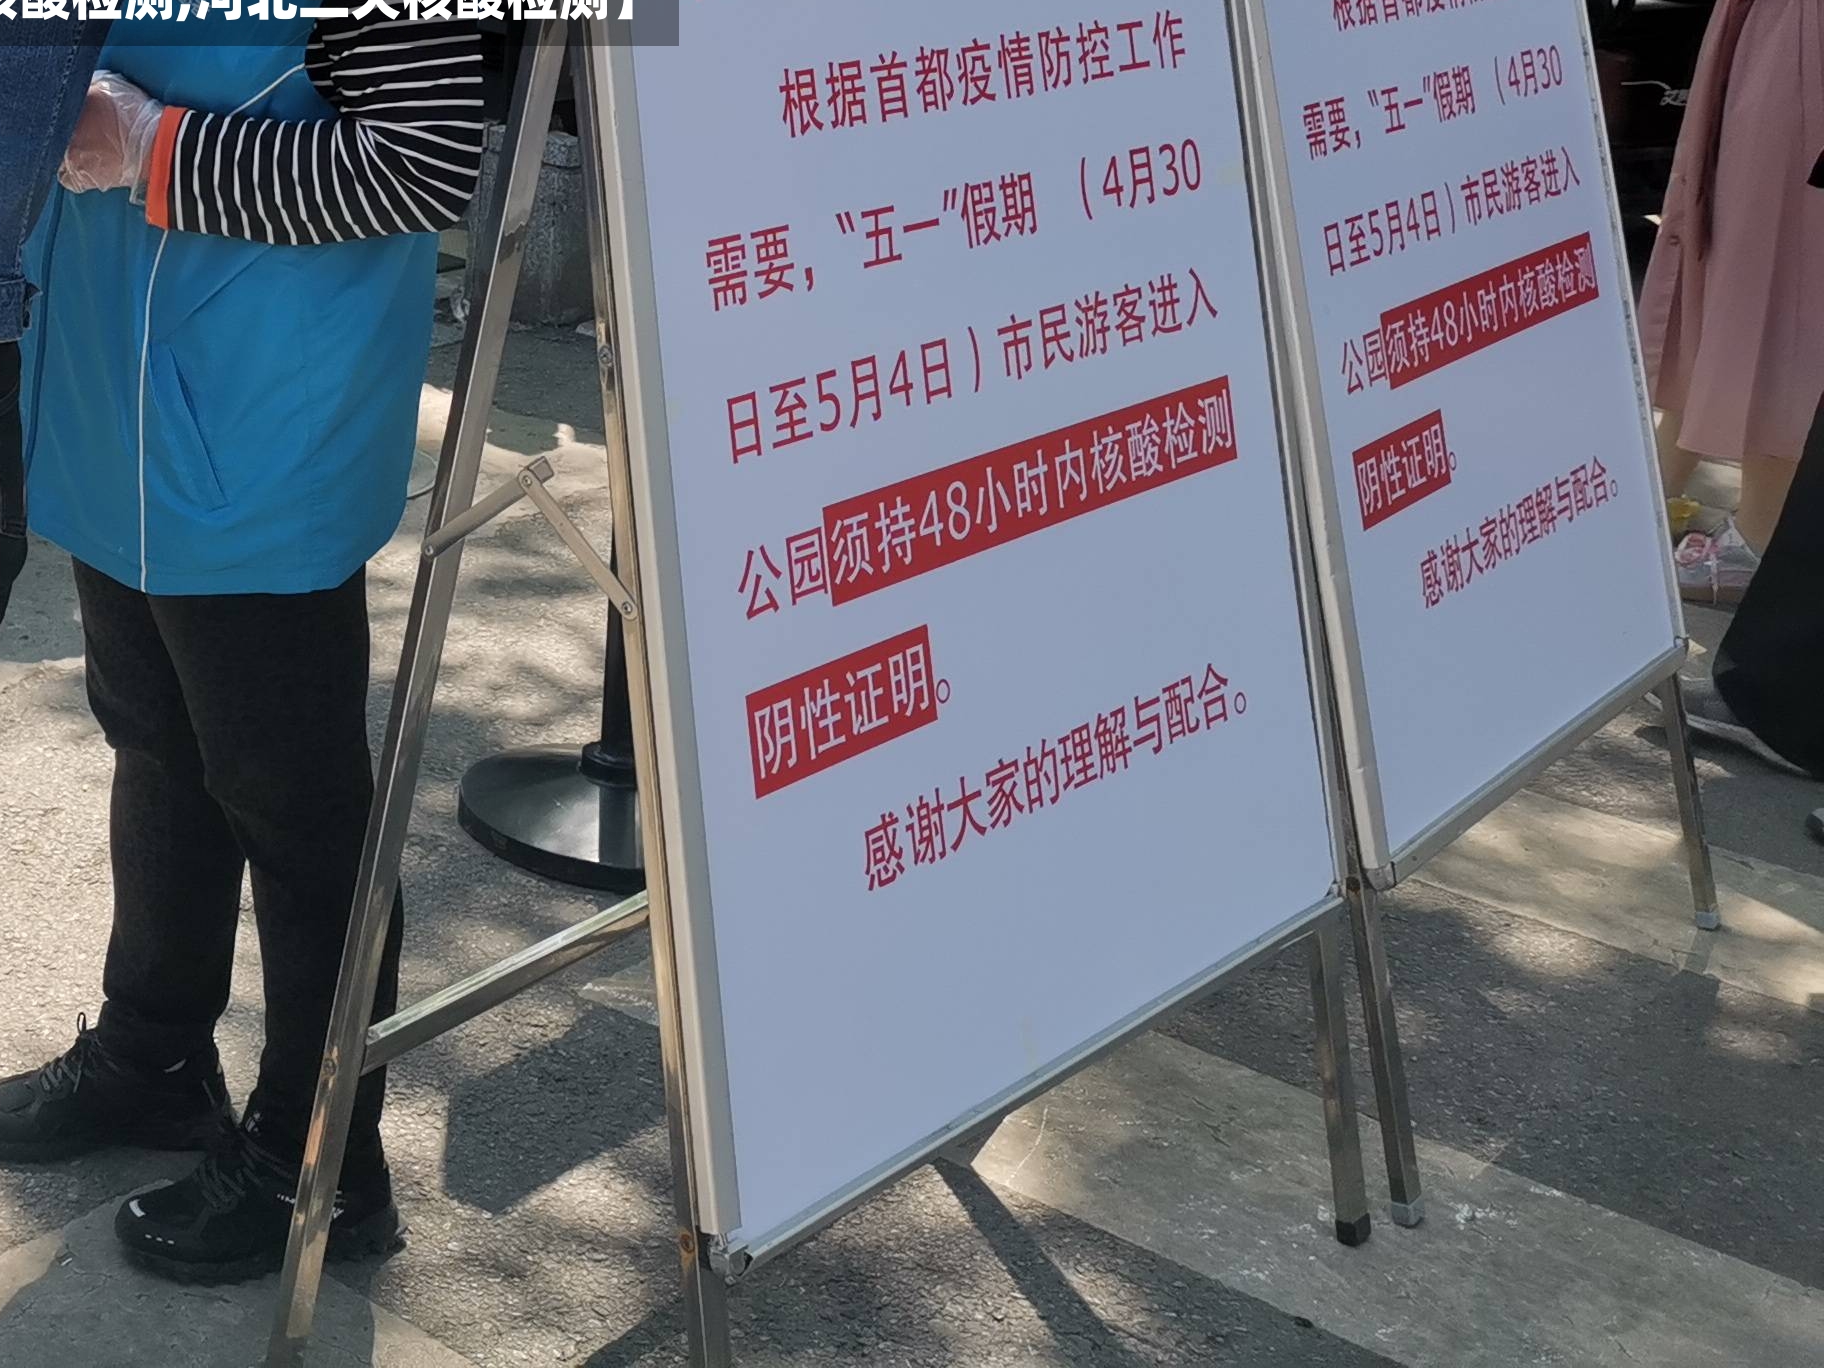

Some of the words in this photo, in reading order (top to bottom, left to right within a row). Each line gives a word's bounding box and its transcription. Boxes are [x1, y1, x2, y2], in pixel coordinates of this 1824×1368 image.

[779, 9, 1186, 138] 根据首都疫情防控工作
[1341, 242, 1597, 396] 公园须持48小时内核酸检测
[737, 388, 1233, 620] 公园须持48小时内核酸检测
[1357, 422, 1457, 516] 阴性证明。
[1420, 456, 1619, 609] 感谢大家的理解与配合。
[754, 640, 952, 780] 阴性证明。
[863, 663, 1248, 892] 感谢大家的理解与配合。
